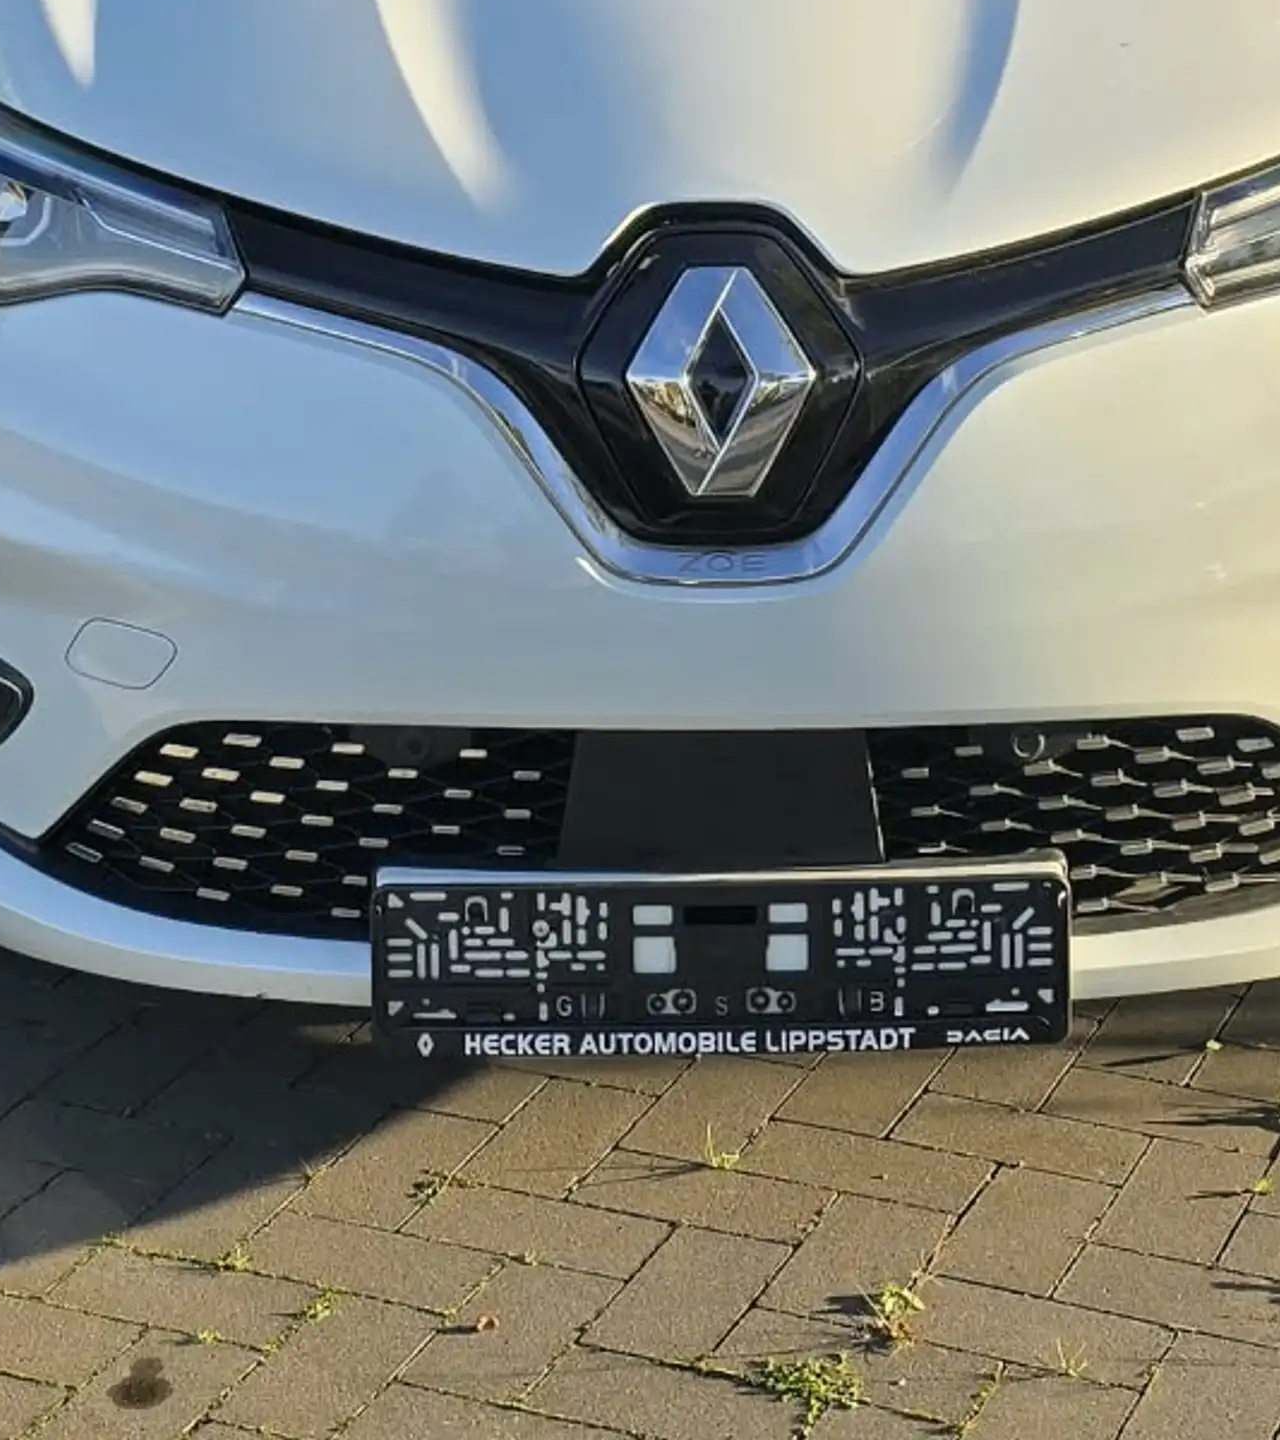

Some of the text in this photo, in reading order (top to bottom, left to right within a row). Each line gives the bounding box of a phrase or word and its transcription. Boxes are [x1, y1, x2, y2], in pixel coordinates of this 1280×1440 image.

[678, 553, 766, 573] ZOE
[464, 1026, 1030, 1056] HECKER AUTOMOBILE LIPPSTADT DACIA
